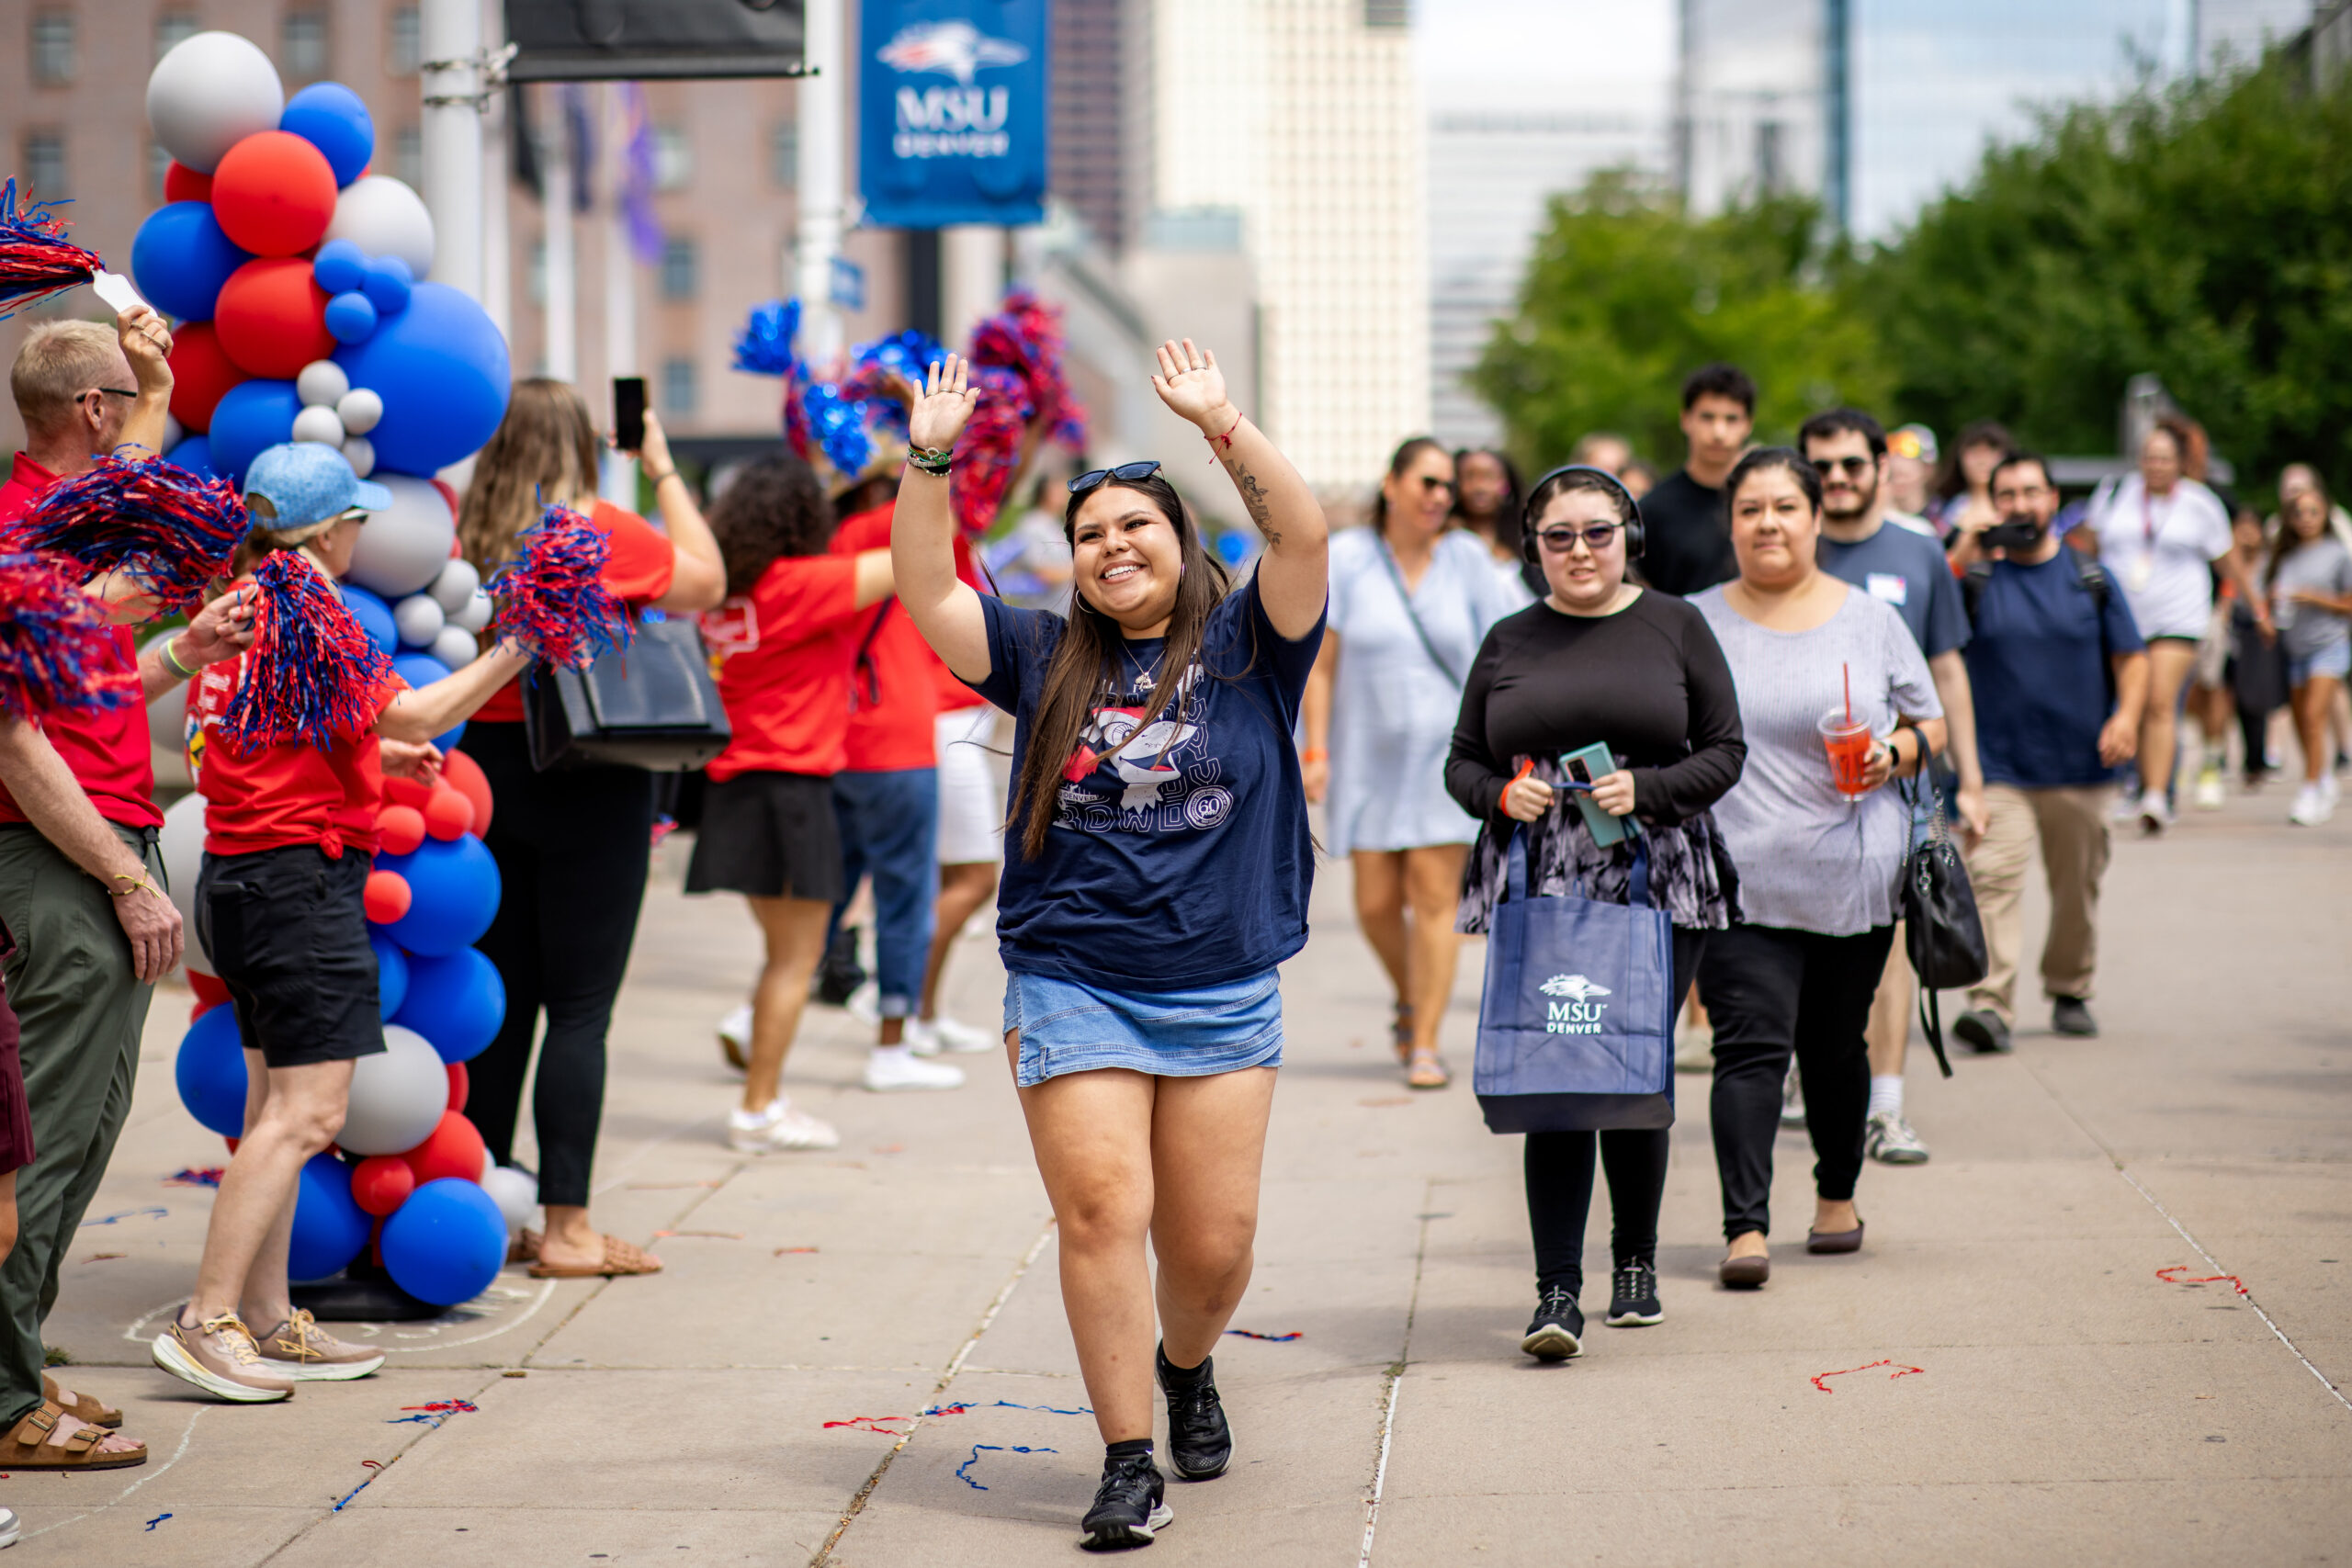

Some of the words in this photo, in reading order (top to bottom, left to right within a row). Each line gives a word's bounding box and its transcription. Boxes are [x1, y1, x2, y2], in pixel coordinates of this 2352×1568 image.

[896, 85, 1009, 131] MSU
[1064, 792, 1096, 801] DENVER
[1198, 797, 1220, 814] 60
[1547, 1001, 1601, 1022] MSU
[1546, 1021, 1602, 1034] DENVER
